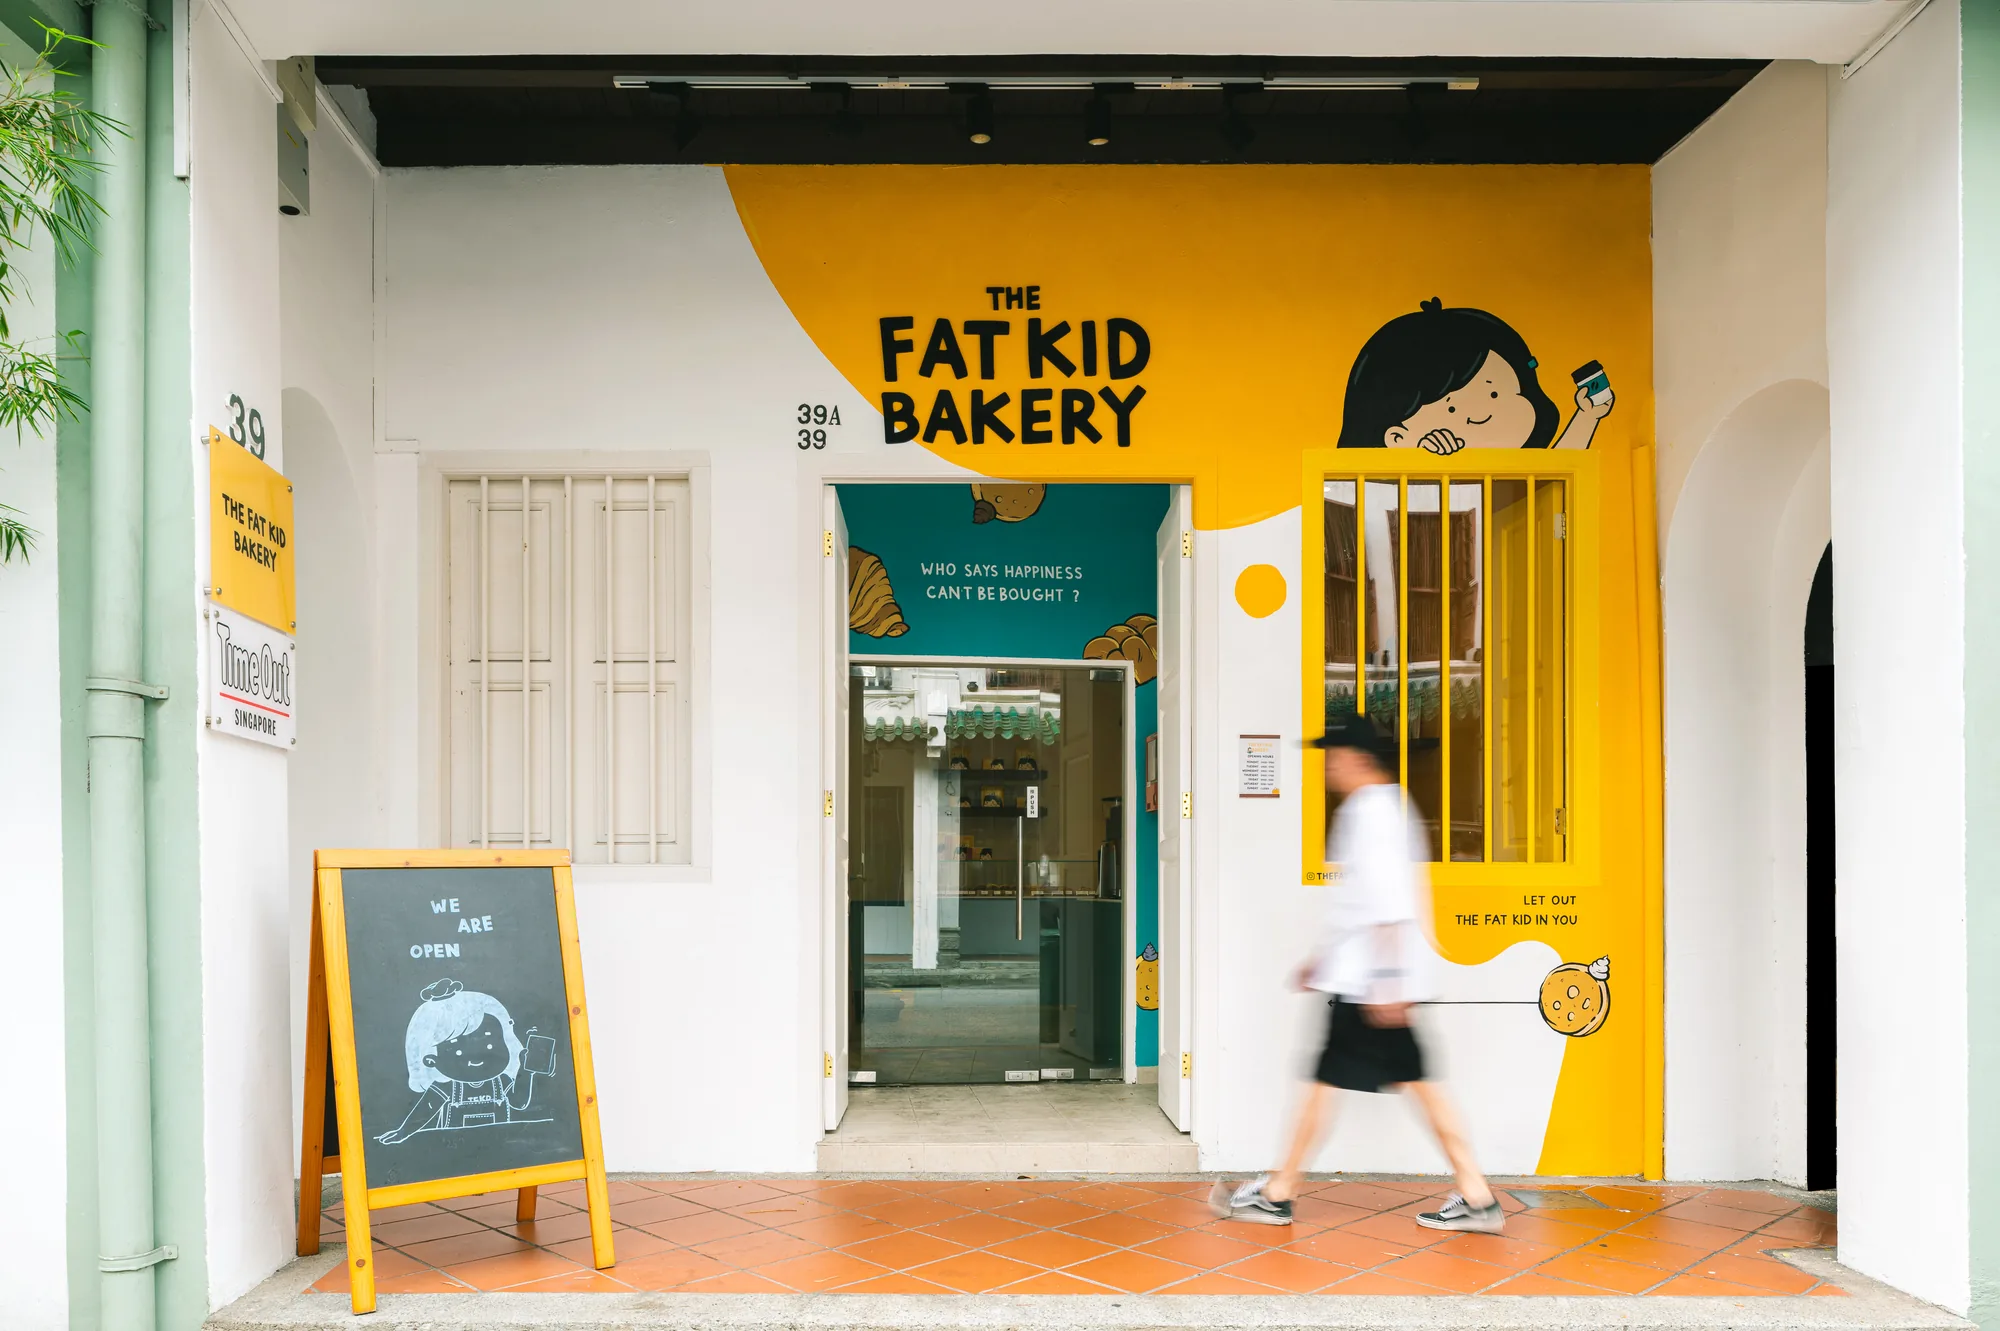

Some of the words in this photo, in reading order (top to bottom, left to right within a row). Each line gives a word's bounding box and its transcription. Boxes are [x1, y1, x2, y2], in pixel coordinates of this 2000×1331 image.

[986, 286, 1041, 310] THE
[880, 316, 1010, 382] FAT
[1027, 318, 1151, 380] KID
[797, 403, 842, 426] 39A
[881, 385, 1147, 447] BAKERY
[225, 393, 265, 461] 39
[797, 429, 827, 450] 39
[222, 493, 245, 525] THE
[247, 507, 267, 537] FAT
[268, 522, 286, 549] KID
[233, 530, 277, 572] BAKERY
[920, 562, 957, 577] WHO
[964, 563, 999, 578] SAYS
[1004, 565, 1083, 580] HAPPINESS
[977, 586, 995, 601] BE
[999, 587, 1064, 602] BOUGHT
[216, 621, 260, 696] Time
[260, 643, 291, 707] Out
[234, 708, 277, 736] SINGAPORE
[430, 897, 461, 914] WE
[1523, 895, 1546, 906] LET
[1551, 895, 1577, 906] OUT
[457, 915, 494, 934] ARE
[1455, 914, 1479, 926] THE
[1484, 914, 1508, 926] FAT
[1512, 914, 1532, 926] KID
[1535, 914, 1548, 926] IN
[1551, 914, 1578, 926] YOU
[409, 943, 461, 959] OPEN
